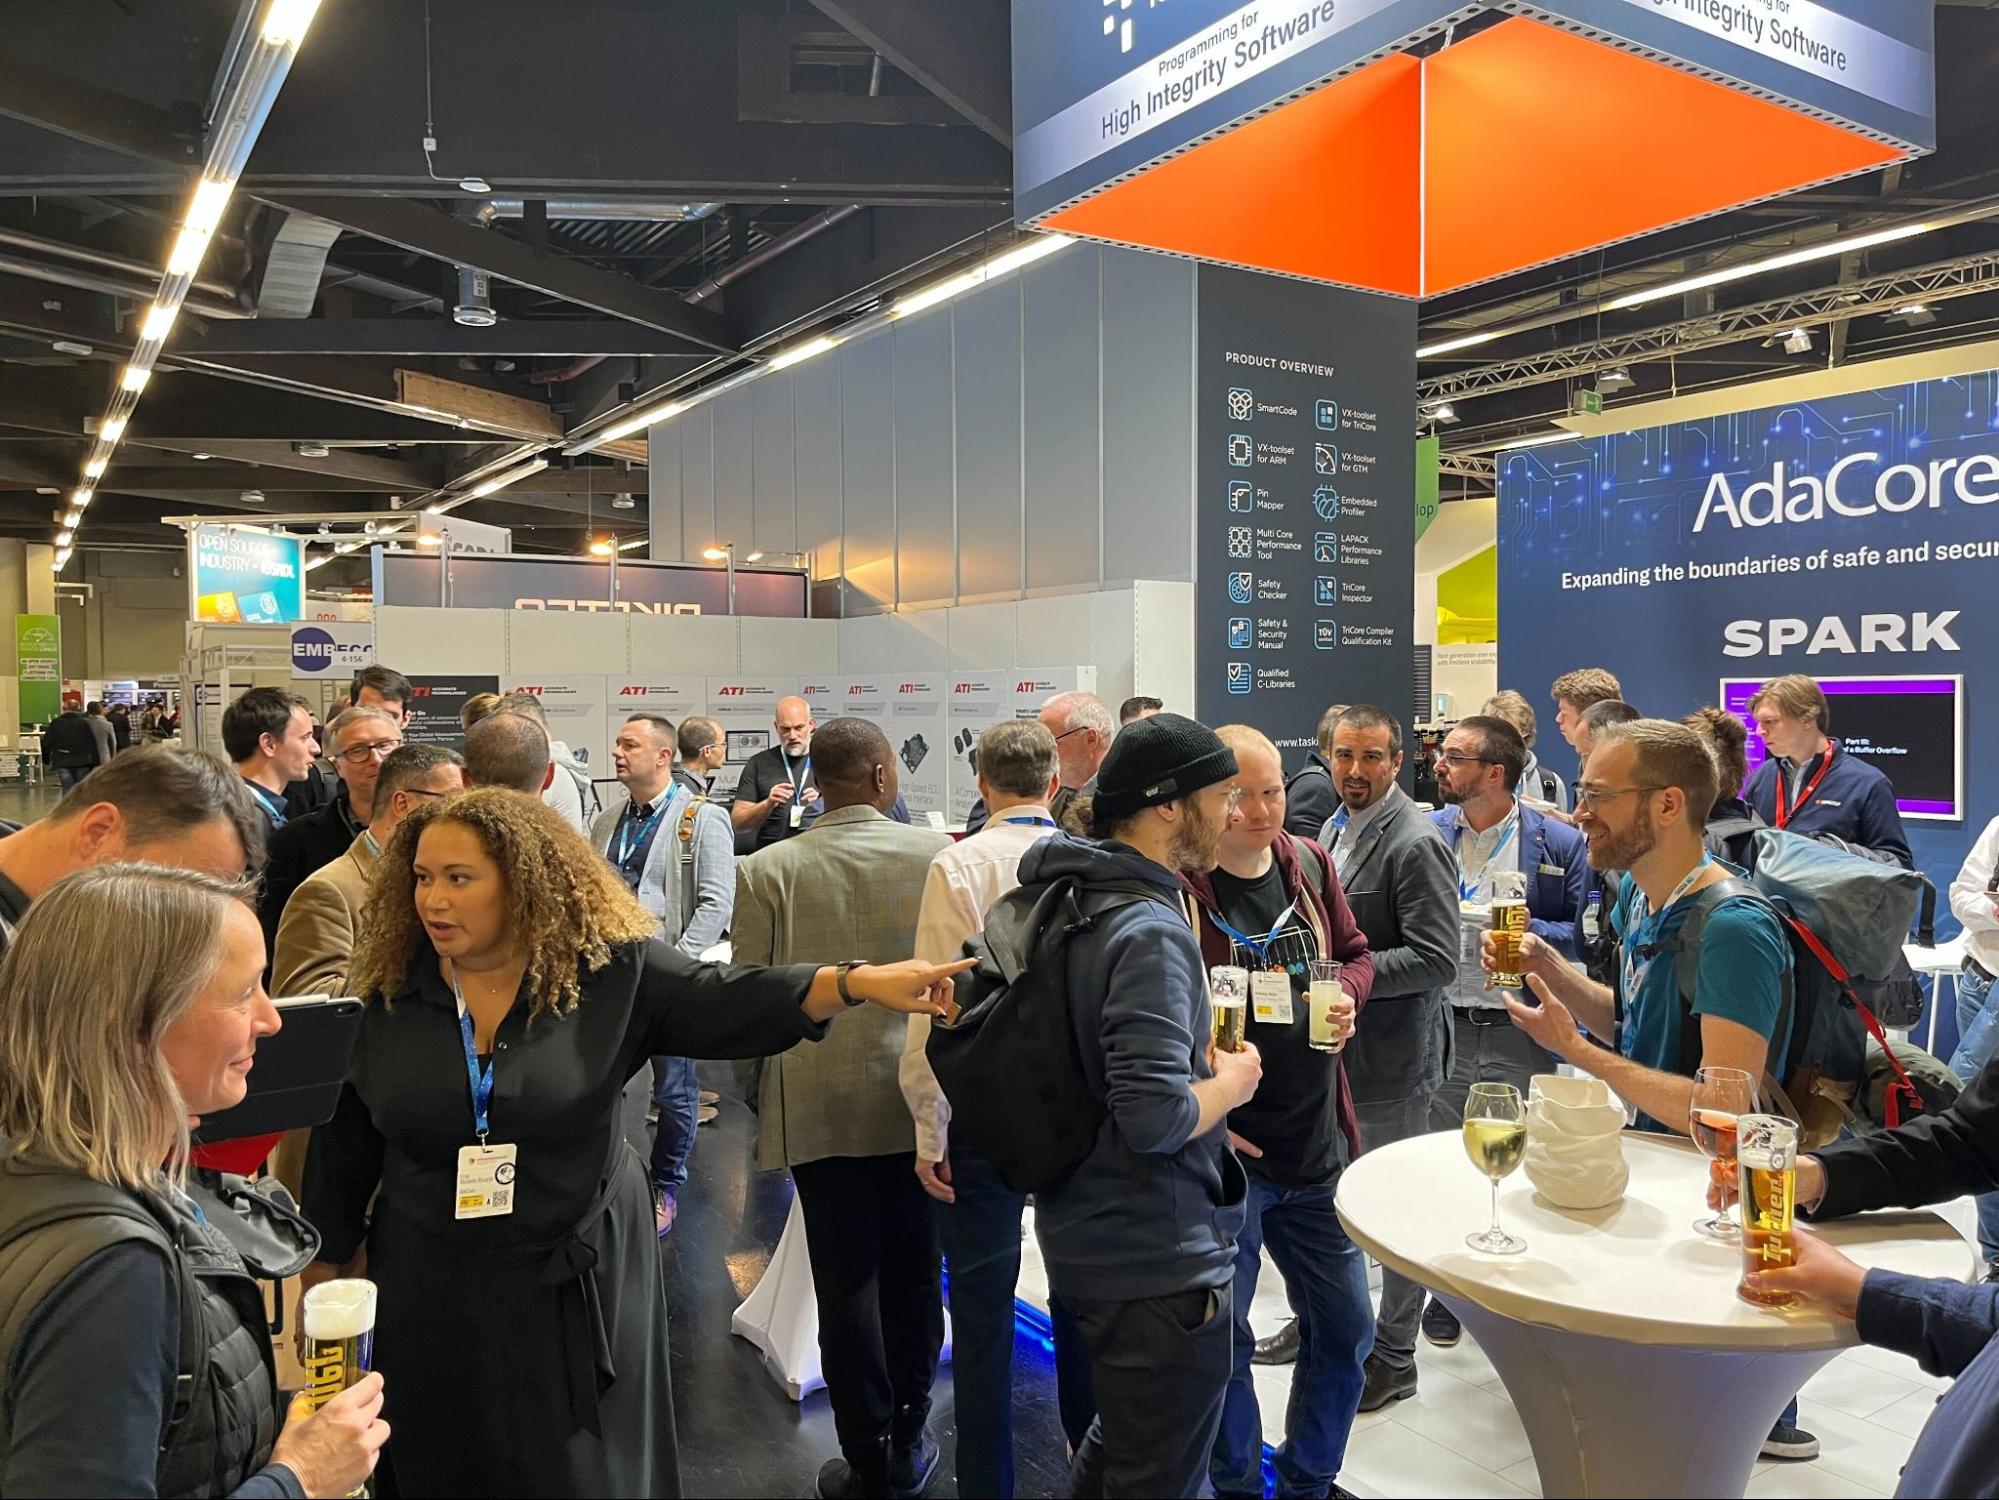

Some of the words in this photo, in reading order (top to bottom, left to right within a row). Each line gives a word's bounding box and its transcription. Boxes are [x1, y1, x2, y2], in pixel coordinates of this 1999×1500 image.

[1158, 22, 1238, 76] Programming
[1241, 10, 1260, 31] for
[1770, 18, 1847, 71] Software
[1102, 100, 1141, 139] High
[1147, 57, 1227, 115] Integrity
[1234, 0, 1335, 69] Software
[1226, 351, 1277, 369] PRODUCT
[1280, 359, 1334, 377] OVERVIEW
[1257, 403, 1297, 416] SmartCode
[1342, 408, 1377, 421] VX-toolset
[1342, 419, 1352, 429] for
[1353, 421, 1377, 432] TriCore
[1257, 443, 1295, 456] VX-toolset
[1257, 454, 1268, 464] for
[1269, 456, 1287, 465] ARM
[1342, 452, 1376, 464] VX-toolset
[1342, 463, 1351, 473] for
[1353, 464, 1368, 474] GTM
[1257, 488, 1269, 498] Pin
[1692, 452, 1999, 532] AdaCore
[1257, 500, 1284, 512] Mapper
[1342, 496, 1377, 507] Embedded
[1342, 506, 1365, 517] Profiler
[1257, 528, 1275, 538] Multi
[1277, 530, 1293, 539] Core
[1341, 534, 1369, 544] LAPACK
[199, 534, 228, 552] OPEN
[1257, 539, 1302, 551] Performance
[1257, 551, 1273, 560] Tool
[1341, 545, 1383, 556] Performance
[1341, 556, 1370, 566] Libraries
[1562, 567, 1650, 591] Expanding
[1654, 563, 1684, 582] the
[1689, 555, 1800, 579] boundaries
[1806, 550, 1829, 569] of
[1833, 546, 1880, 568] safe
[1886, 541, 1928, 564] and
[1258, 579, 1281, 590] Safety
[1342, 583, 1366, 593] TriCore
[1258, 590, 1287, 600] Checker
[1342, 593, 1373, 604] Inspector
[1258, 618, 1281, 629] Safety
[1282, 619, 1288, 628] &
[1258, 630, 1287, 640] Security
[1342, 626, 1366, 636] TriCore
[1367, 627, 1394, 637] Compiler
[1723, 611, 1961, 657] SPARK
[1258, 641, 1284, 650] Manual
[1342, 636, 1382, 646] Qualification
[1383, 637, 1392, 646] Kit
[342, 655, 363, 663] 4-156
[1258, 669, 1289, 679] Qualified
[899, 684, 913, 693] ATI
[954, 683, 971, 693] ATI
[1016, 681, 1034, 692] ATI
[1258, 679, 1295, 689] C-Libraries
[516, 686, 544, 696] ATI
[620, 686, 648, 695] ATI
[718, 686, 745, 695] ATI
[804, 686, 816, 695] ATI
[849, 685, 862, 695] ATI
